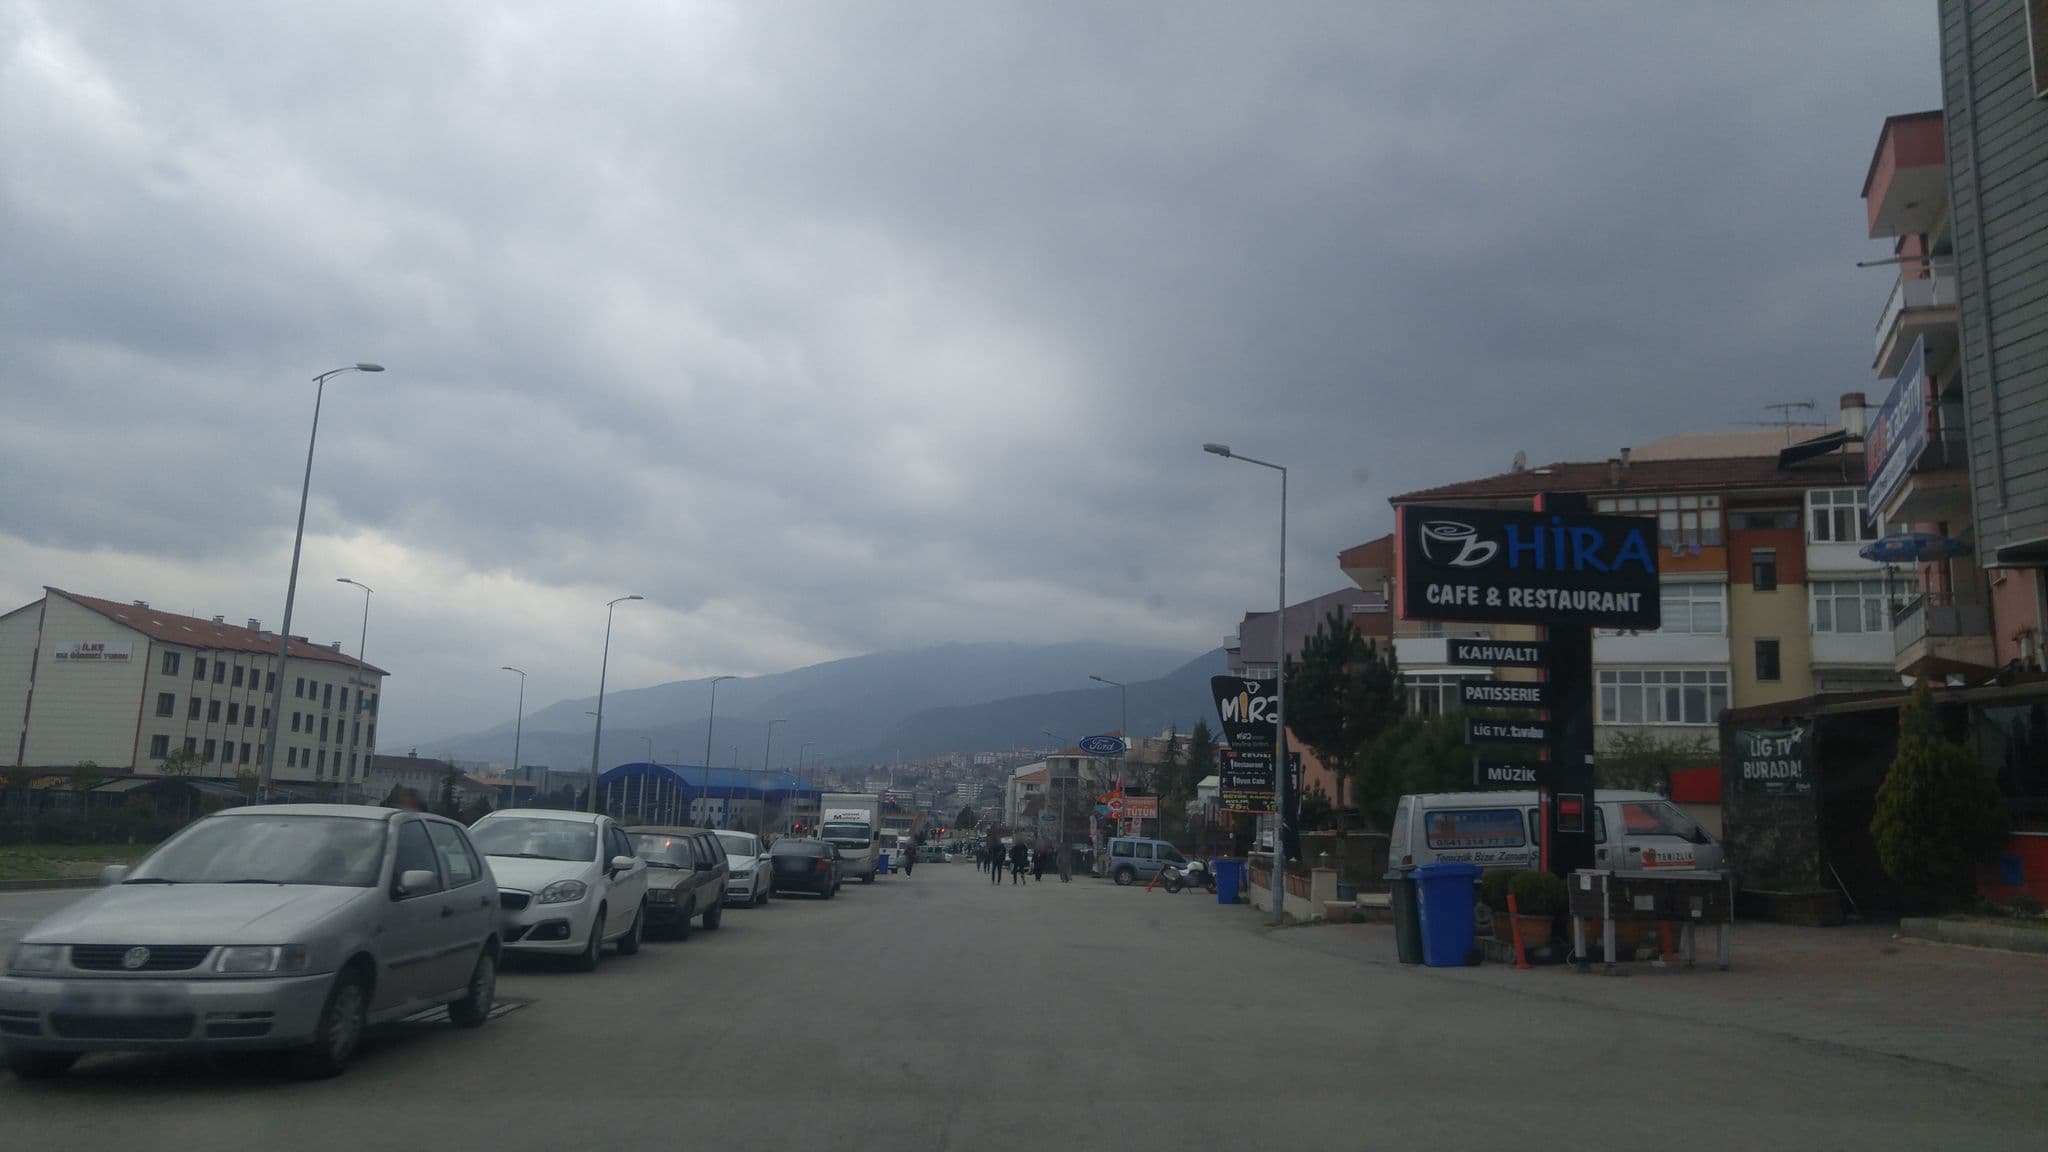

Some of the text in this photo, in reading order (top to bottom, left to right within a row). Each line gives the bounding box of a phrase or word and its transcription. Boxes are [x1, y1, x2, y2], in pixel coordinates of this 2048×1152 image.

[1504, 516, 1656, 573] HİRA
[1426, 583, 1642, 613] CAFE & RESTAURANT
[1457, 645, 1539, 663] KAHVALTI
[1465, 685, 1541, 702] PATISSERIE
[1089, 738, 1115, 751] Ford
[1751, 735, 1792, 756] LİG TV
[1487, 765, 1537, 782] MÜZİK
[1743, 760, 1802, 778] BURADA!
